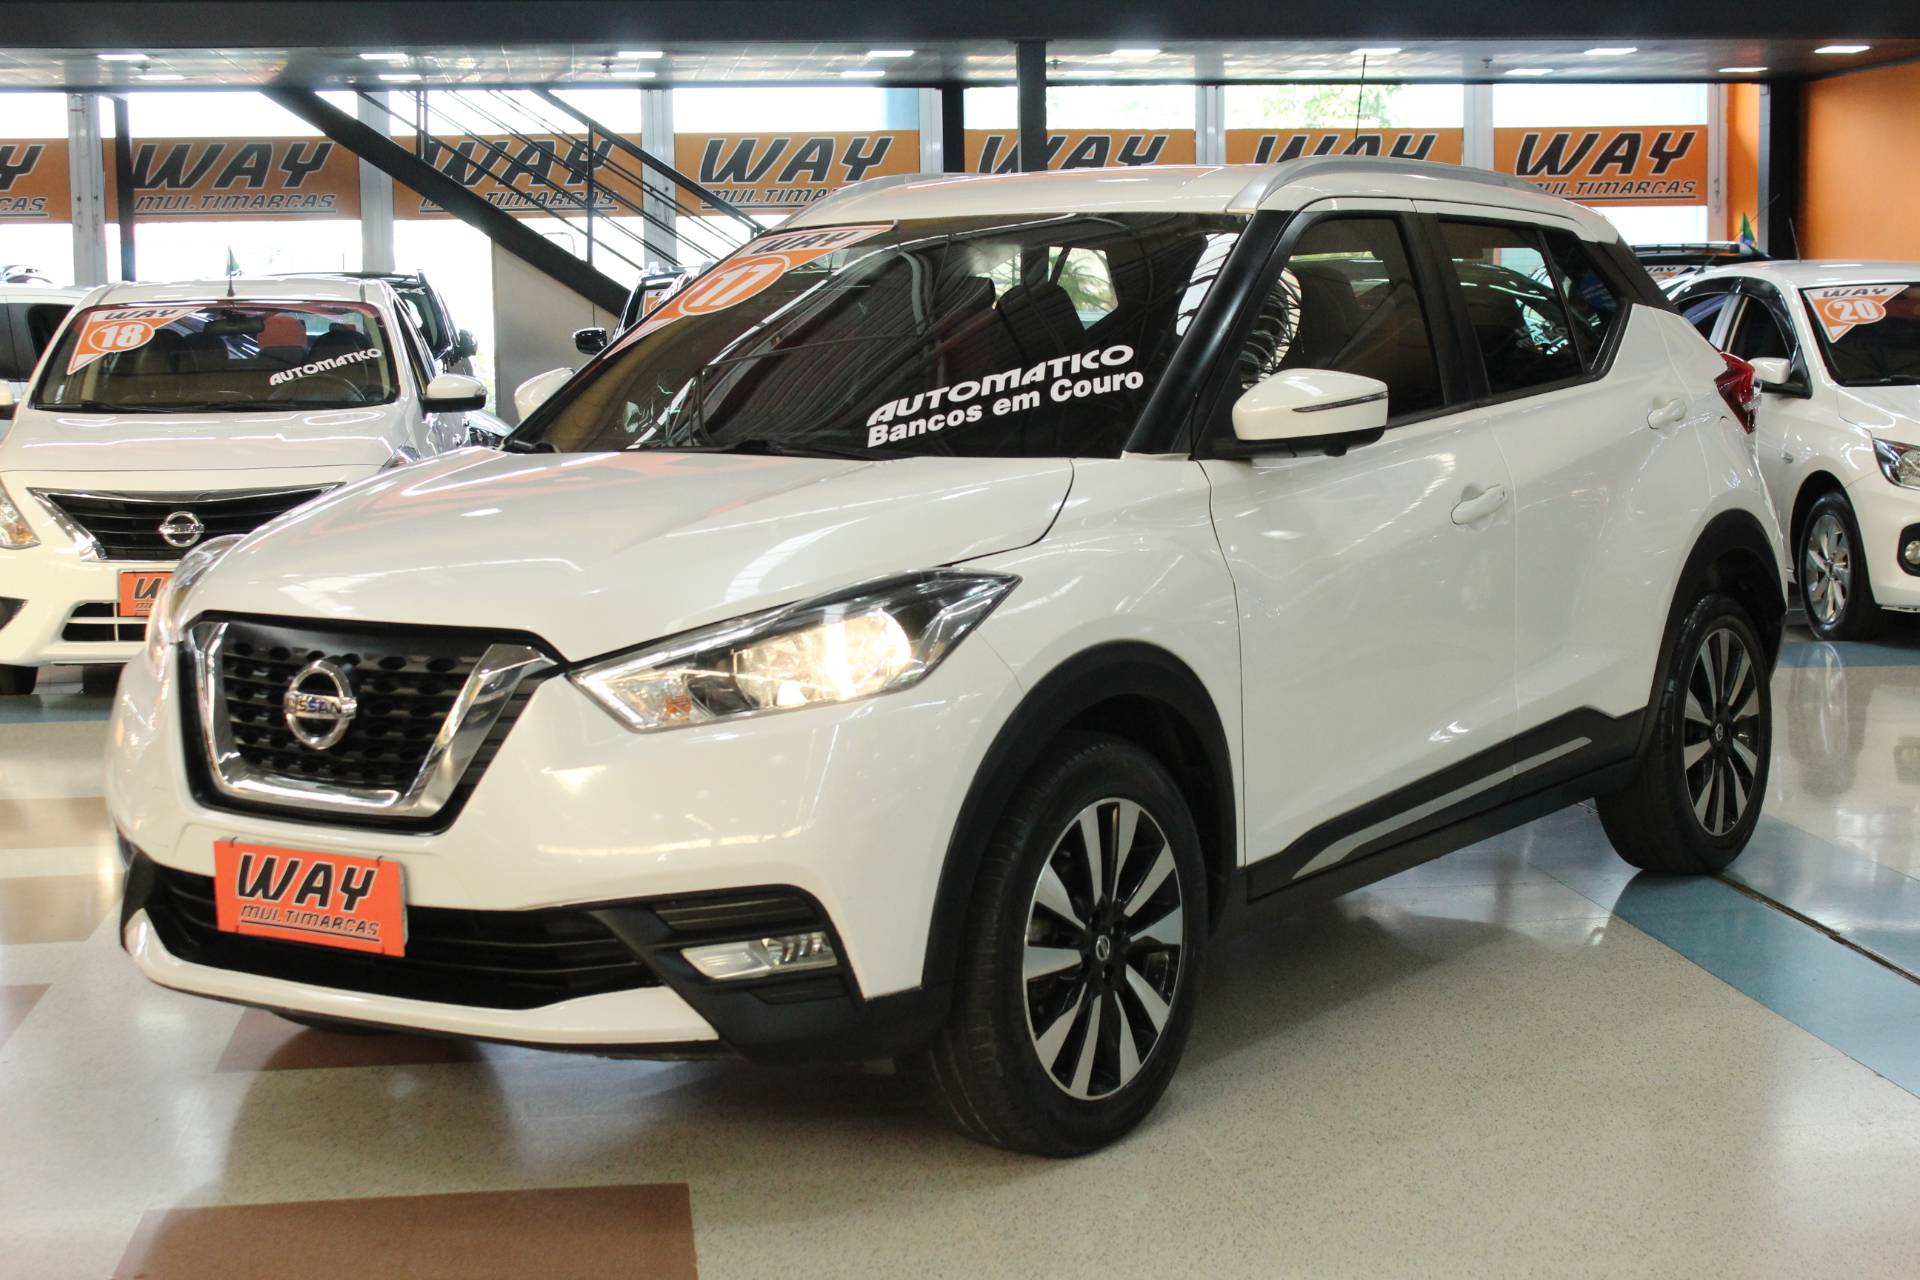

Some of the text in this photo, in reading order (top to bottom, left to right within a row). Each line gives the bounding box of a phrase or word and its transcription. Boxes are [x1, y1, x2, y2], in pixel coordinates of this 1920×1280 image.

[133, 141, 336, 190] WAY
[700, 136, 894, 182] WAY
[1515, 131, 1697, 177] WAY
[135, 193, 336, 210] MULTIMARCAS
[1823, 287, 1888, 297] WAY
[1833, 300, 1879, 320] 20
[104, 308, 178, 320] WAY
[100, 323, 145, 348] 18
[268, 347, 384, 386] AUTOMATICO
[866, 344, 1135, 427] AUTOMATICO
[867, 371, 1144, 448] Bancos em Couro
[235, 852, 378, 914] WAY
[240, 904, 380, 938] MULTIMARCAS
